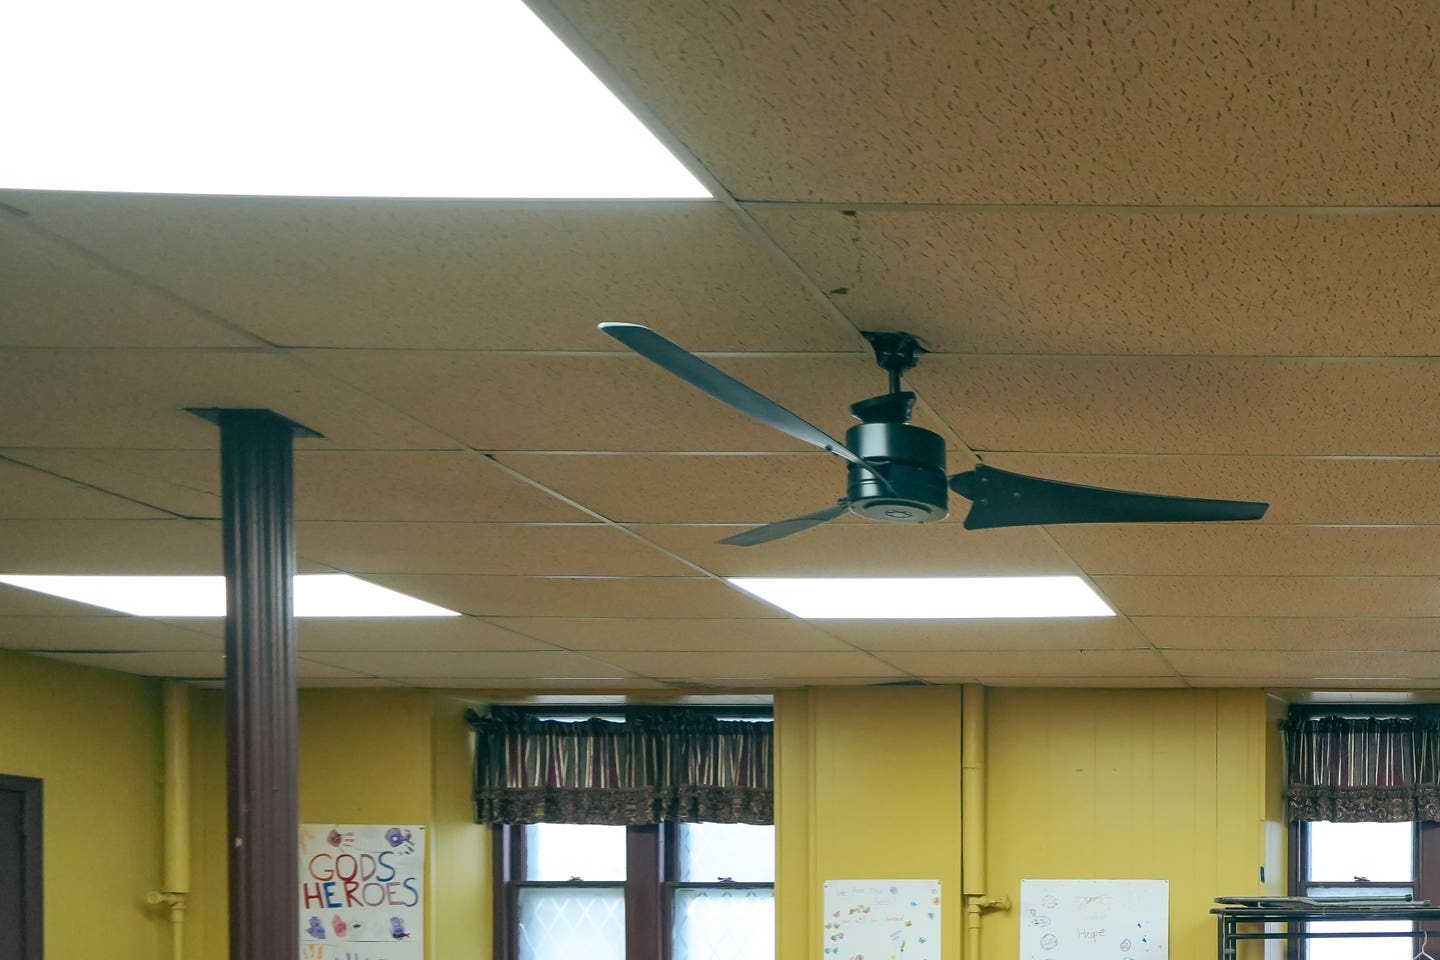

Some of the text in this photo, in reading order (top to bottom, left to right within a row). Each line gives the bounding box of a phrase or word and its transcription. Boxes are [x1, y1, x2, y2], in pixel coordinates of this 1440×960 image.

[308, 851, 396, 882] GODS
[303, 877, 419, 909] HEROES
[1077, 928, 1105, 942] Hope
